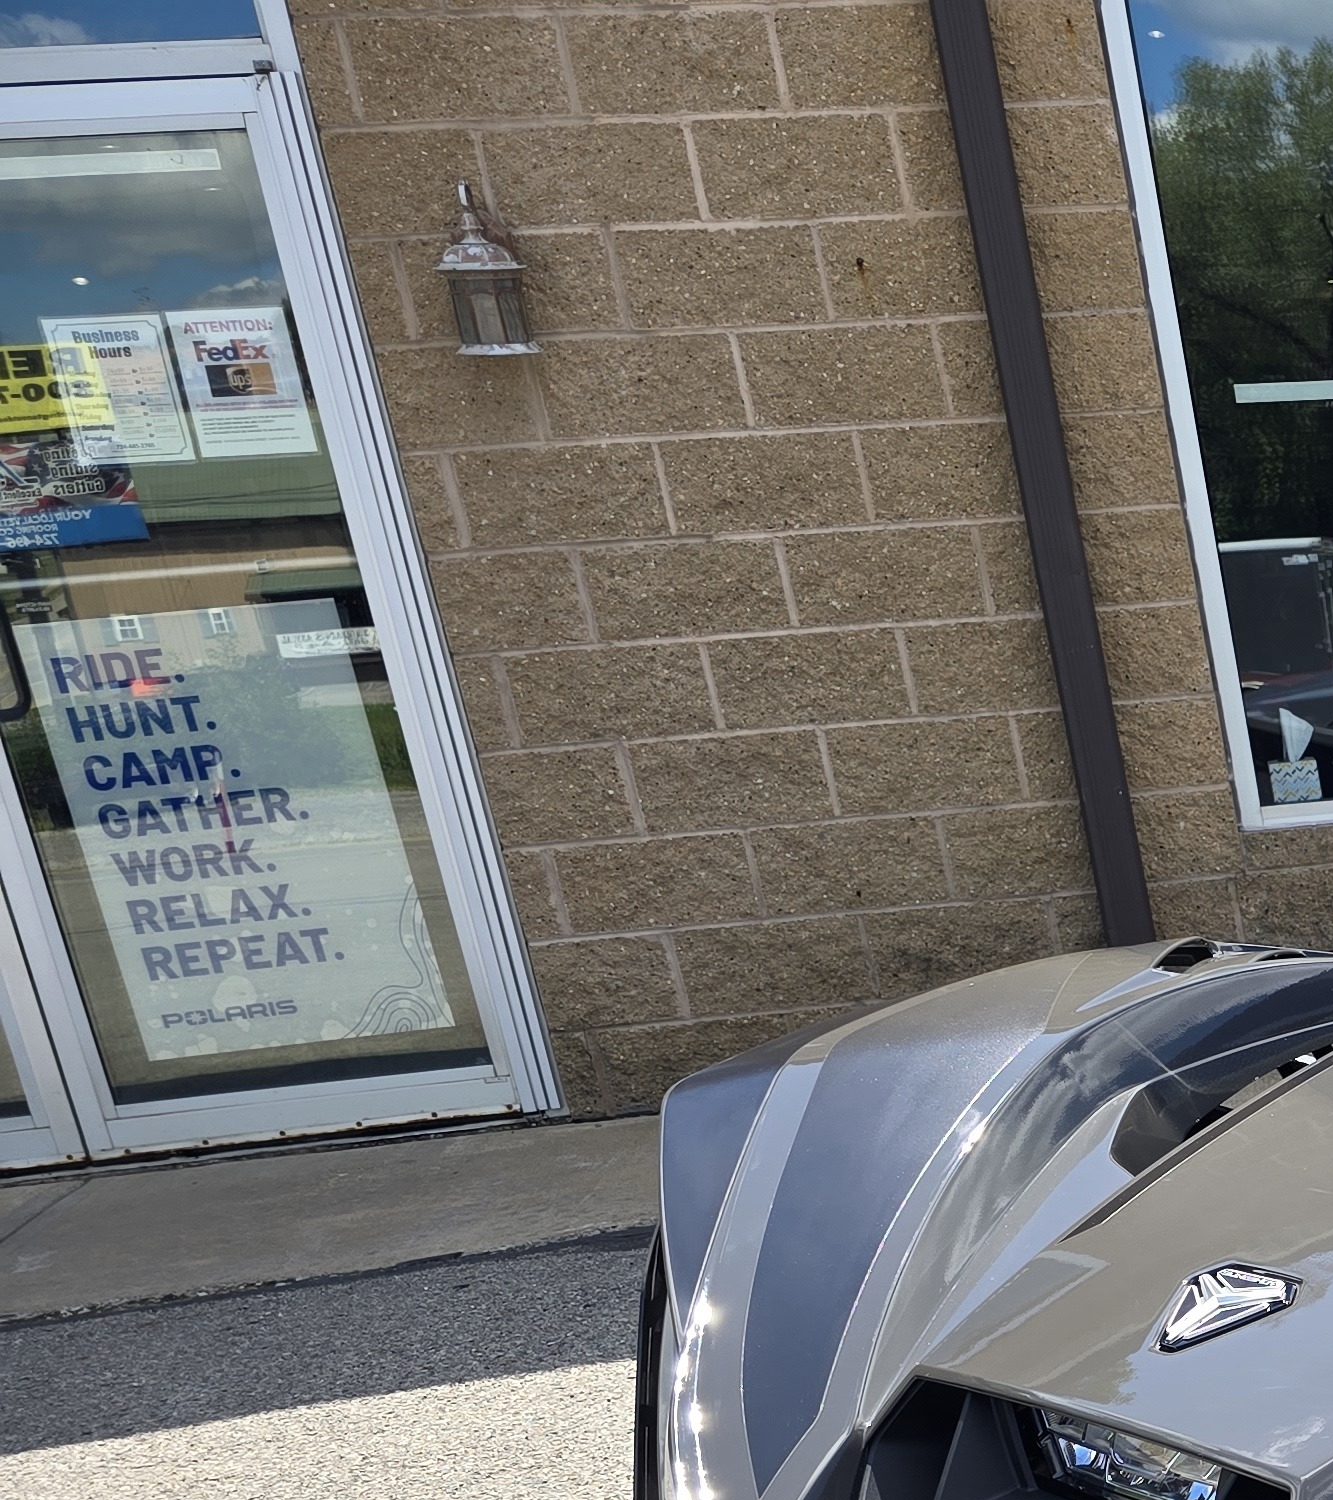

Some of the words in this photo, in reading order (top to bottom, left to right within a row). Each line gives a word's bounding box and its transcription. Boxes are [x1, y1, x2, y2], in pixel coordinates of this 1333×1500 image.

[72, 329, 140, 344] Business
[183, 319, 273, 335] ATTENTION:
[192, 338, 270, 362] FedEx
[88, 345, 132, 360] Hours
[231, 373, 252, 390] ups
[49, 648, 186, 694] RIDE.
[65, 696, 217, 744] HUNT.
[83, 744, 241, 791] CAMP.
[98, 787, 310, 840] GATHER.
[110, 838, 277, 888] WORK.
[126, 883, 311, 935] RELAX.
[140, 928, 345, 982] REPEAT.
[161, 1000, 298, 1029] POLARIS
